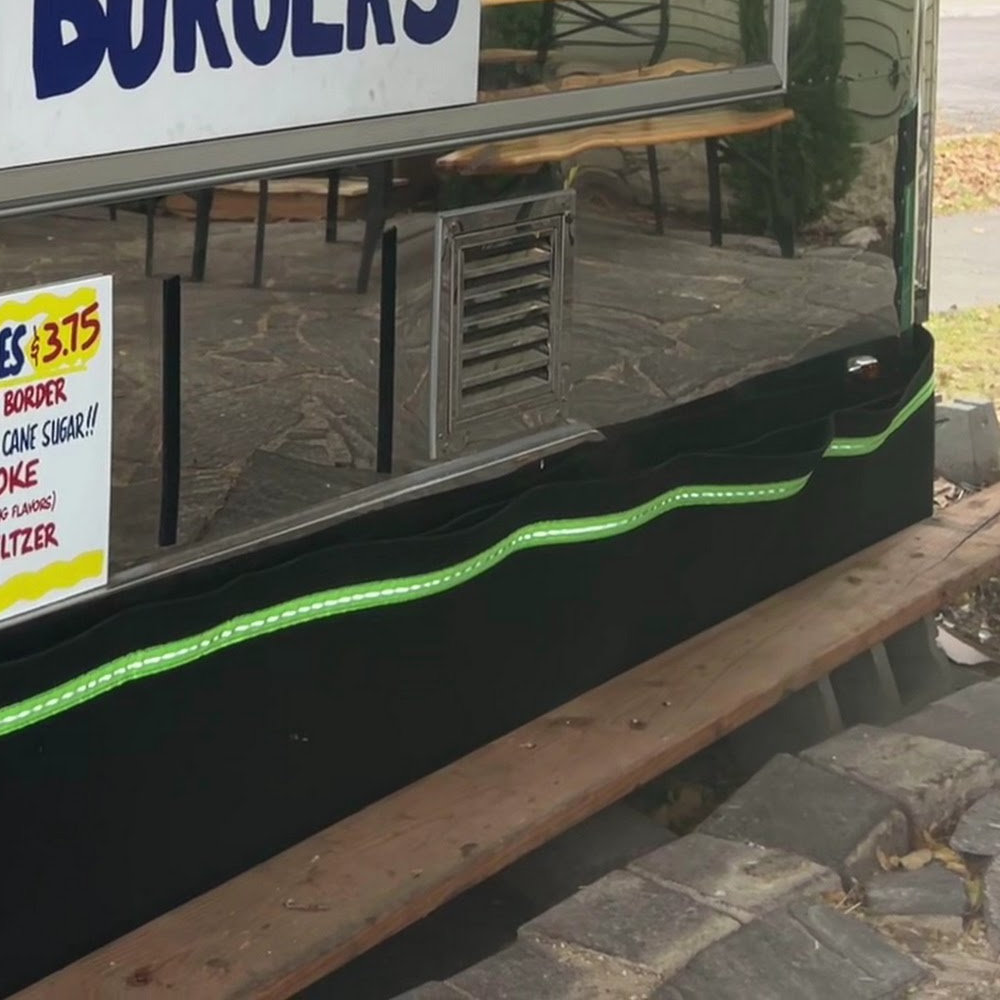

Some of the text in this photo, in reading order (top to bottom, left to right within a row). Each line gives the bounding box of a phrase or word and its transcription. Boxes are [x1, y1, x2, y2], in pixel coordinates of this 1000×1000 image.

[30, 302, 101, 366] $3.75
[3, 377, 67, 416] BORDER
[2, 423, 38, 456] CANE
[41, 402, 99, 447] SUGAR!!
